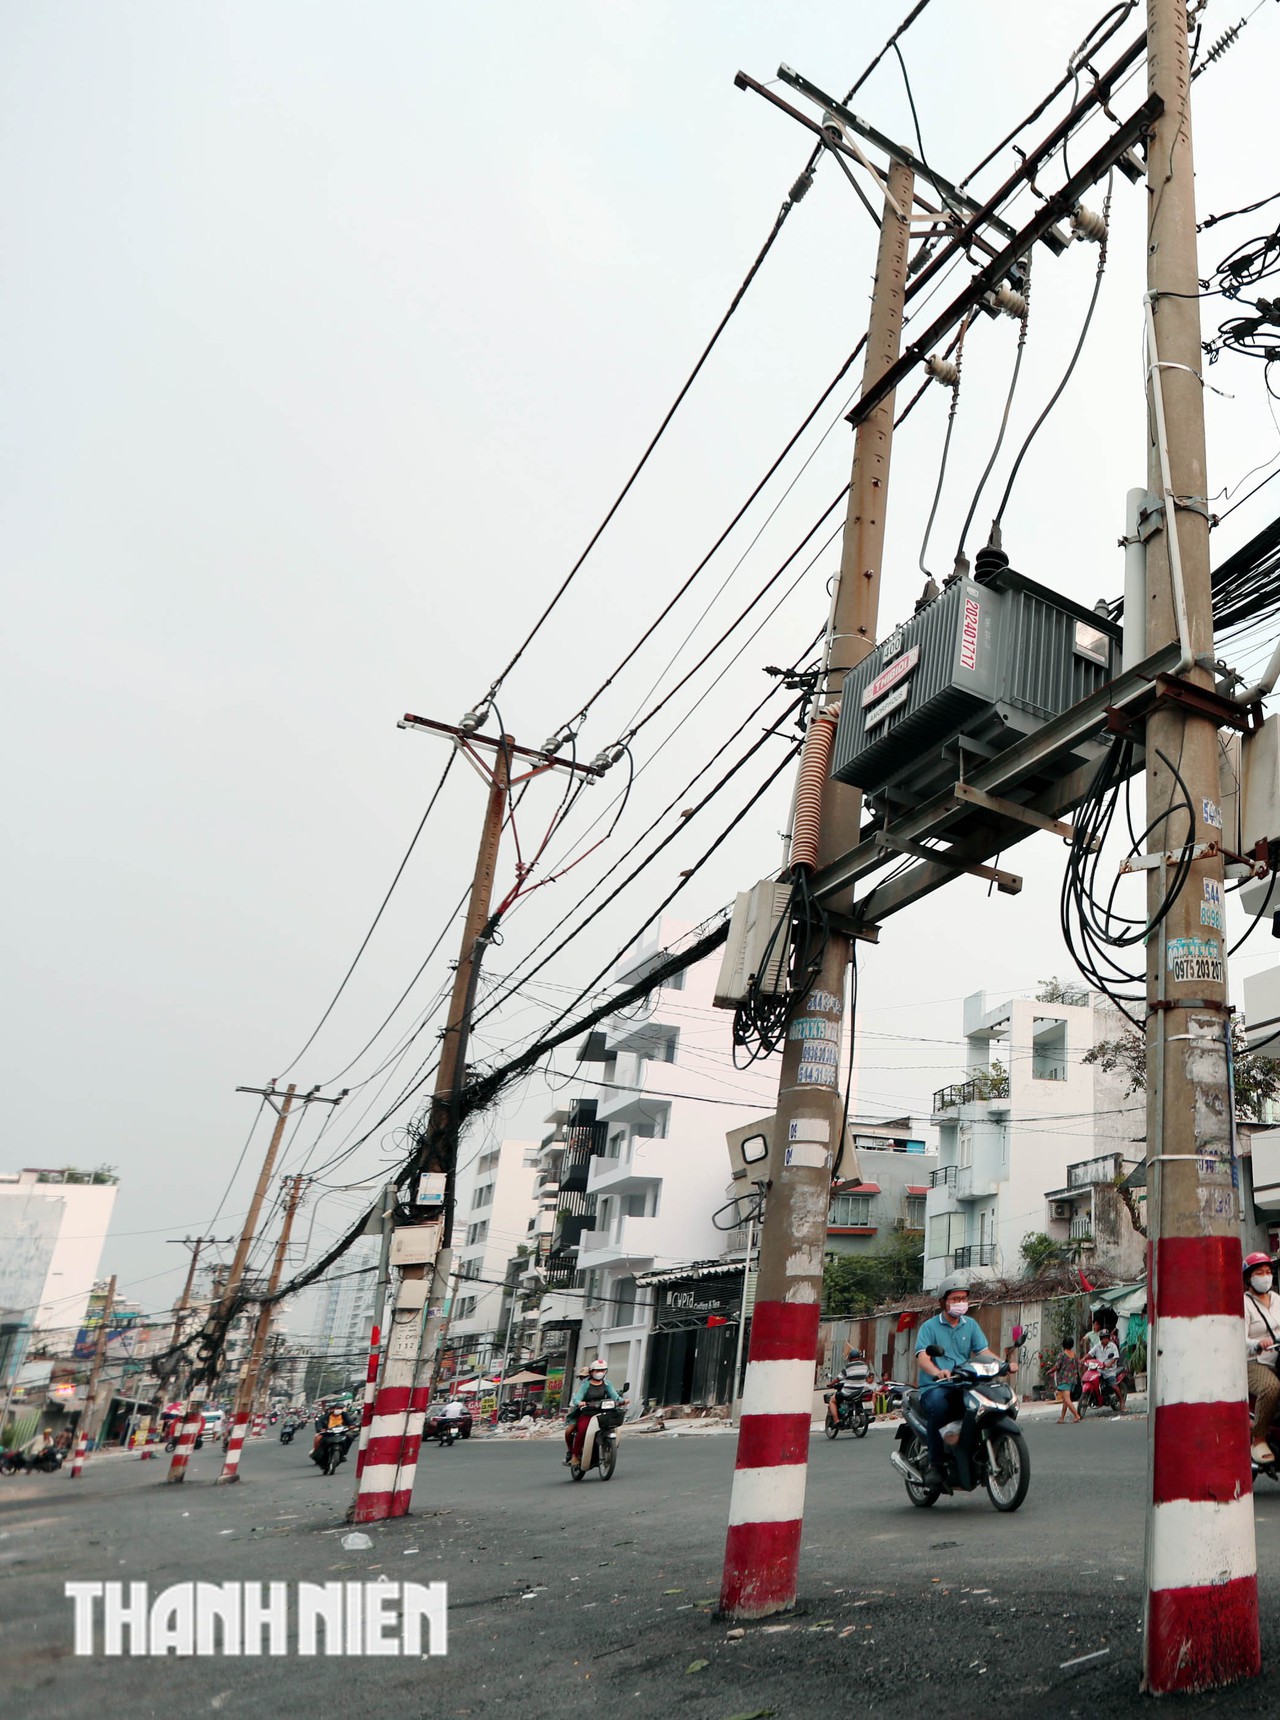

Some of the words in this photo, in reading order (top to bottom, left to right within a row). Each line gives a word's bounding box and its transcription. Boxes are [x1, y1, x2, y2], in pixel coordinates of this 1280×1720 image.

[884, 638, 901, 658] 400
[961, 599, 979, 669] 202401717
[875, 656, 909, 692] THIBIDI
[869, 691, 903, 722] AMORPHOUS
